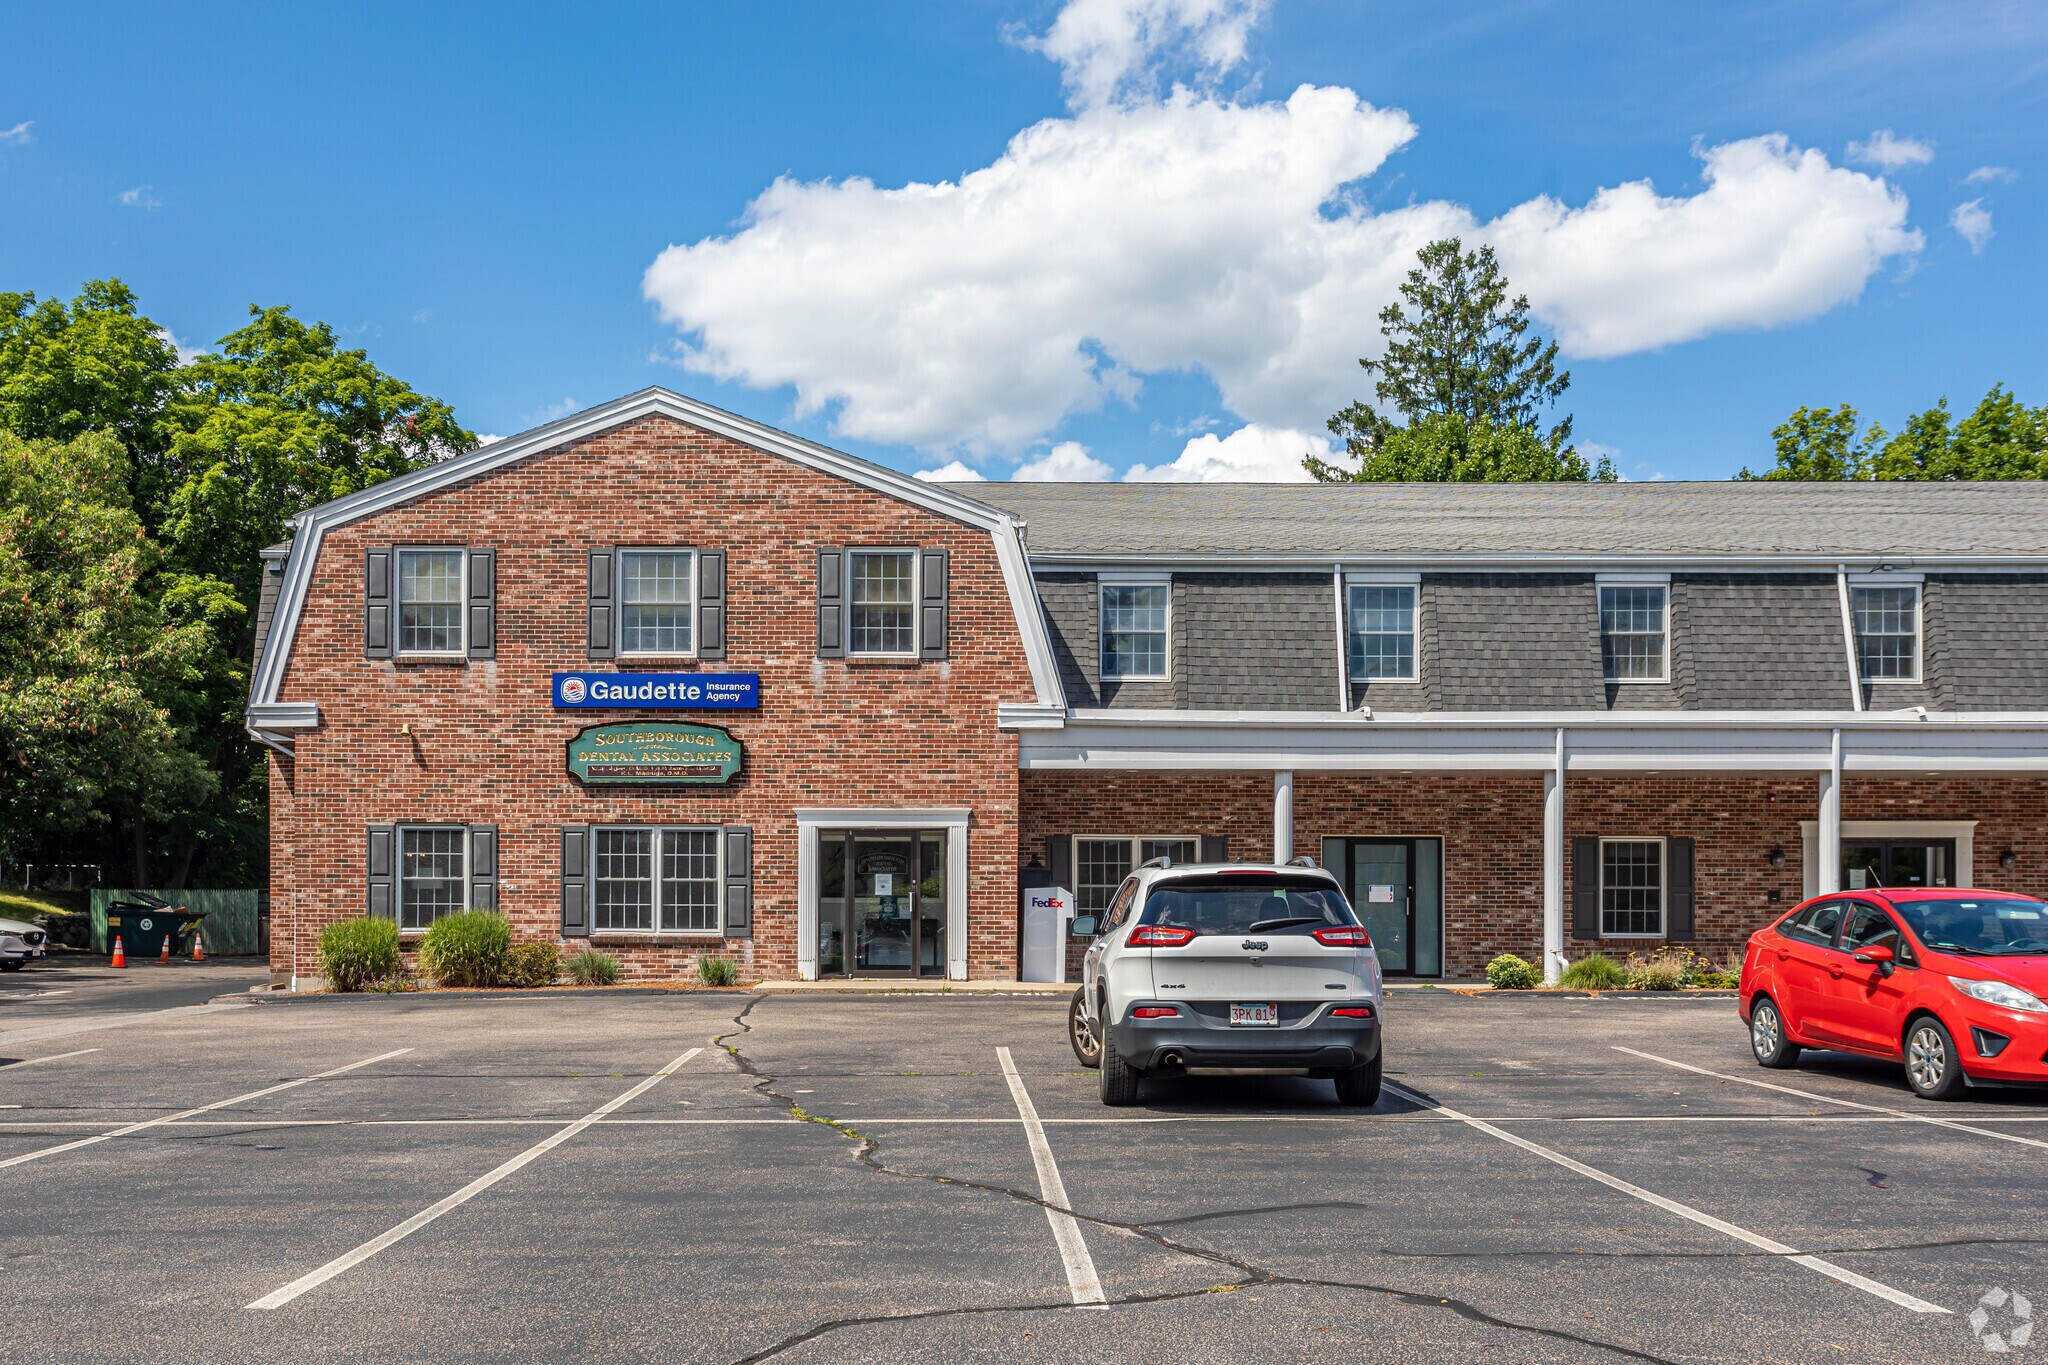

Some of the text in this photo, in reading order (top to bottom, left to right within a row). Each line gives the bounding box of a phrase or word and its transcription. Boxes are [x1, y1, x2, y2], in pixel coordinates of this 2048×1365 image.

[590, 680, 701, 700] Gaudette
[706, 682, 751, 691] Insurance
[706, 691, 741, 702] Agency
[595, 732, 715, 747] SOUTHBOROUGH
[578, 751, 732, 762] DENTAL ASSOCIATES
[1031, 897, 1064, 908] FedEx
[1242, 940, 1269, 952] Jeep
[1231, 1008, 1276, 1021] 3PK 819
